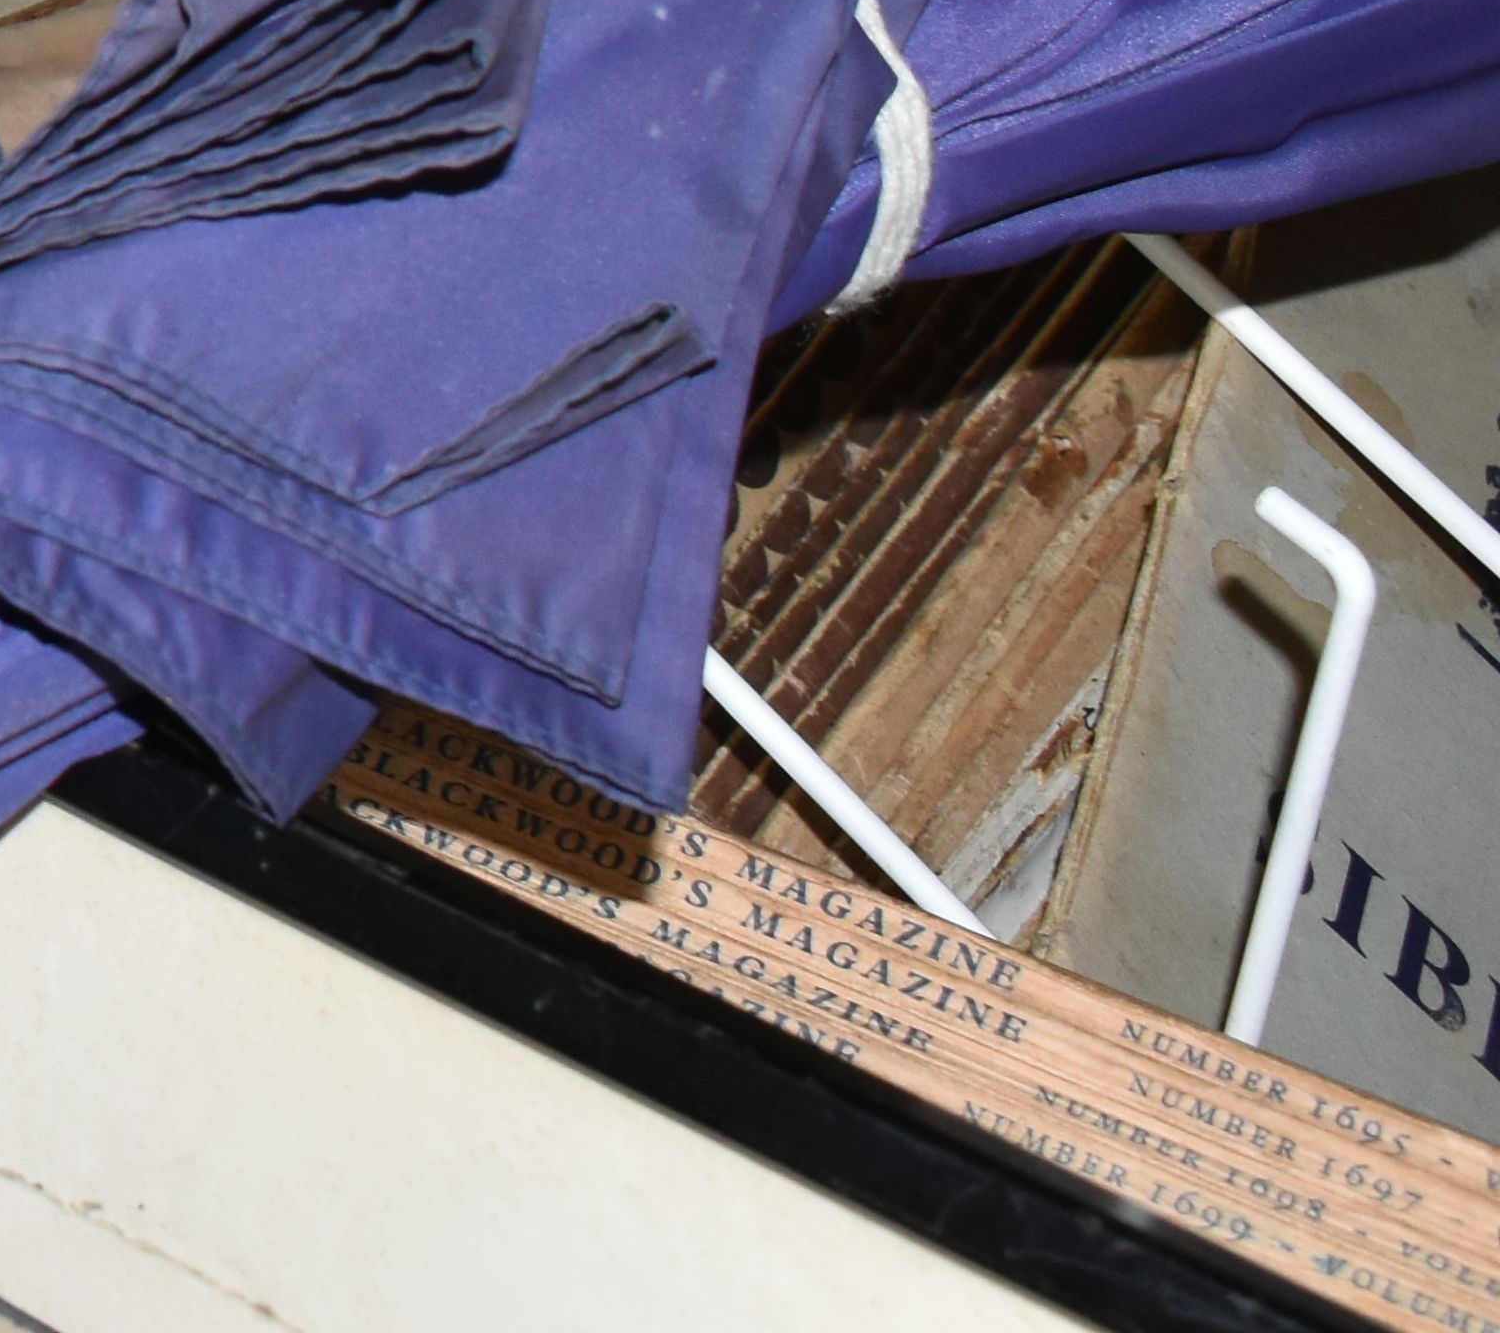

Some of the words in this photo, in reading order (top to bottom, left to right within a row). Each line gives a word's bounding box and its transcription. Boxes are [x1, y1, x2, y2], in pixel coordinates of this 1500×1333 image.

[650, 919, 935, 1053] MAGAZINE
[1034, 1084, 1202, 1171] NUMBER
[1223, 1165, 1328, 1222] 1698
[735, 853, 1023, 992] MAGAZINE
[1119, 1017, 1290, 1104] NUMBER
[1309, 1097, 1414, 1156] 1695
[740, 902, 1029, 1044] MAGAZINE
[1127, 1070, 1298, 1161] NUMBER
[1319, 1155, 1425, 1213] 1697
[962, 1099, 1131, 1191] NUMBER
[1148, 1182, 1256, 1245] 1699
